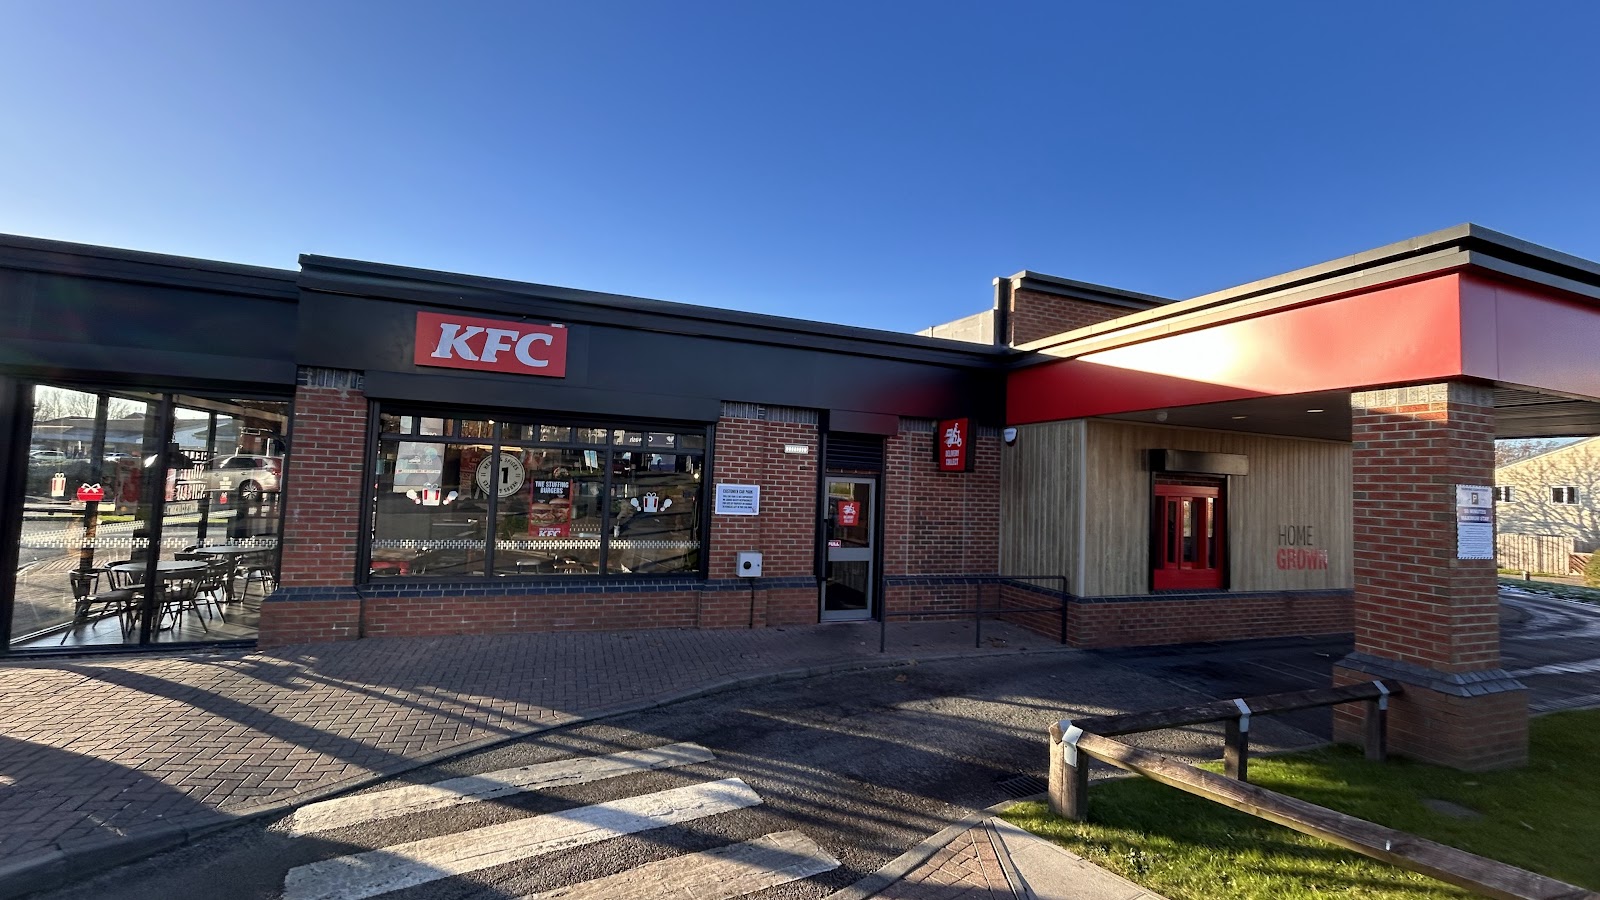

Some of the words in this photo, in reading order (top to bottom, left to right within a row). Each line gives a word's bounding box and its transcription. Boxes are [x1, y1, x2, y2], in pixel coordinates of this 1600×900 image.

[431, 323, 553, 367] KFC
[504, 457, 519, 471] SPICES
[502, 467, 508, 484] 1
[1472, 494, 1478, 503] P
[1278, 525, 1313, 546] HOME
[1277, 548, 1328, 570] GROWN
